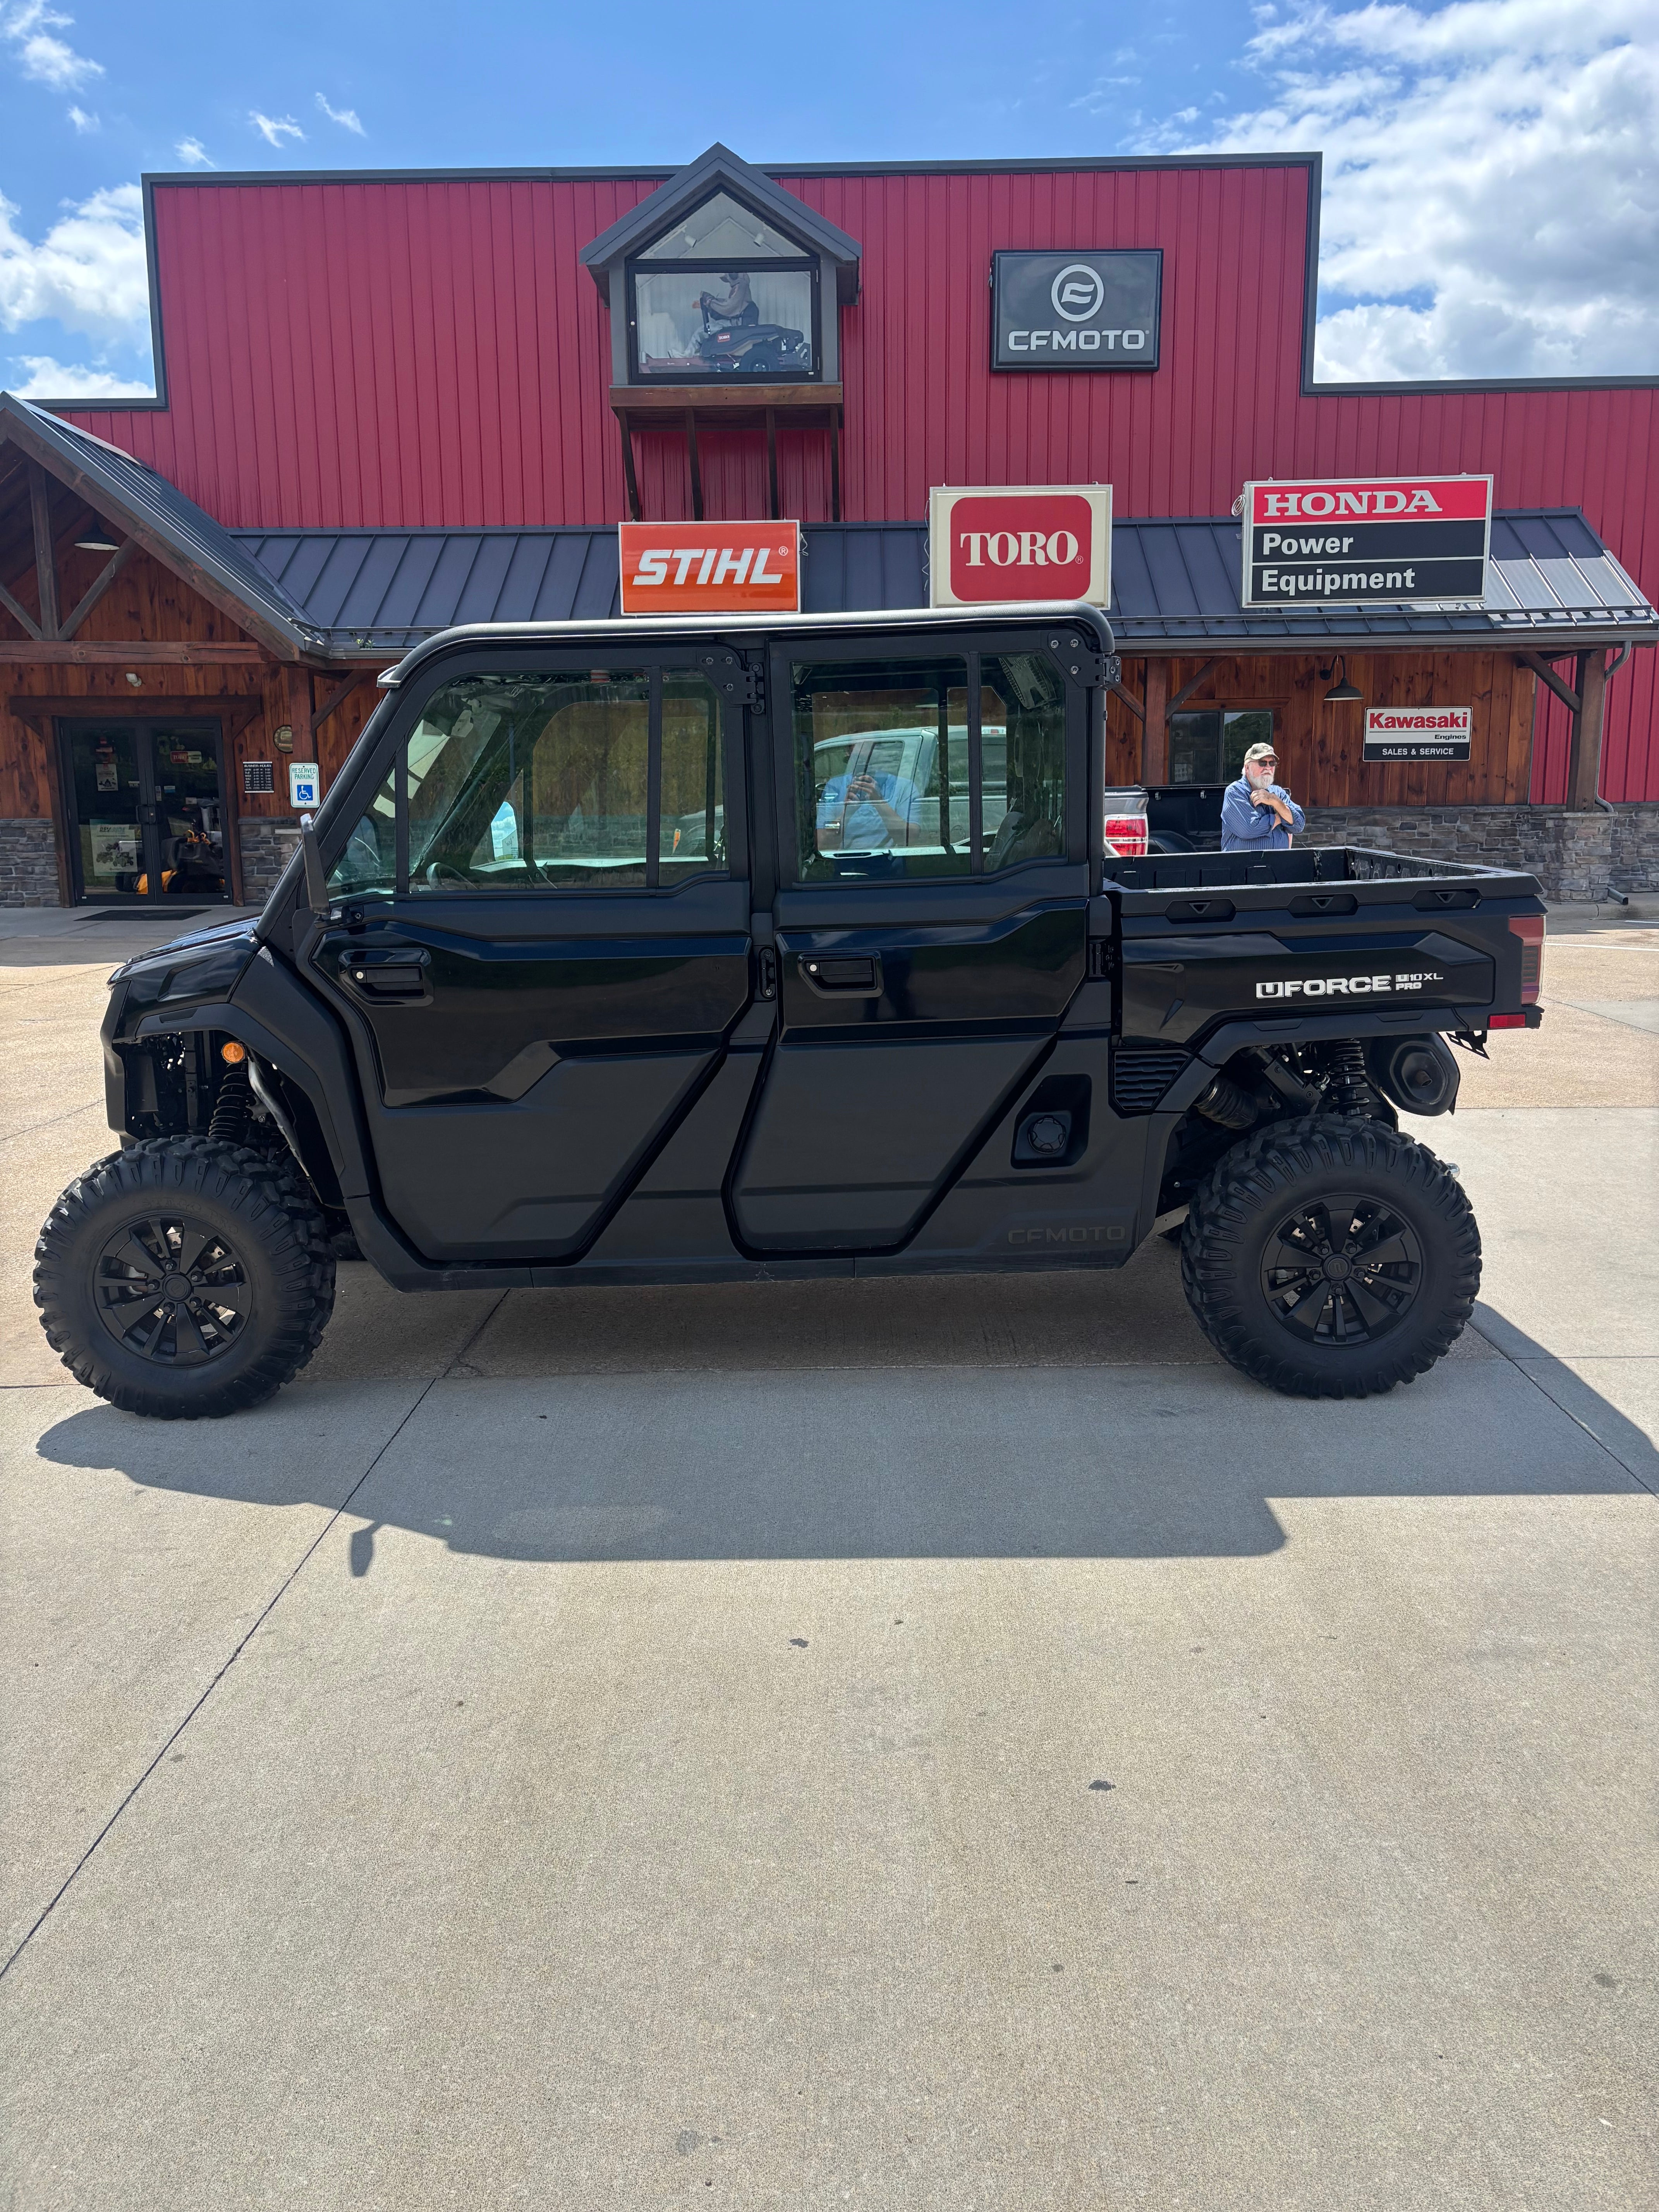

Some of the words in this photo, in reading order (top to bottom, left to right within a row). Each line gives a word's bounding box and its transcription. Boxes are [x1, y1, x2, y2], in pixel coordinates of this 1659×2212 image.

[1008, 330, 1145, 350] CFMOTO
[1264, 490, 1443, 517] HONDA
[1263, 533, 1353, 555] Power
[1262, 568, 1415, 596] Equipment
[1369, 712, 1468, 729] Kawasaki
[1395, 982, 1422, 991] PRO
[1008, 1226, 1125, 1244] CFMOTO
